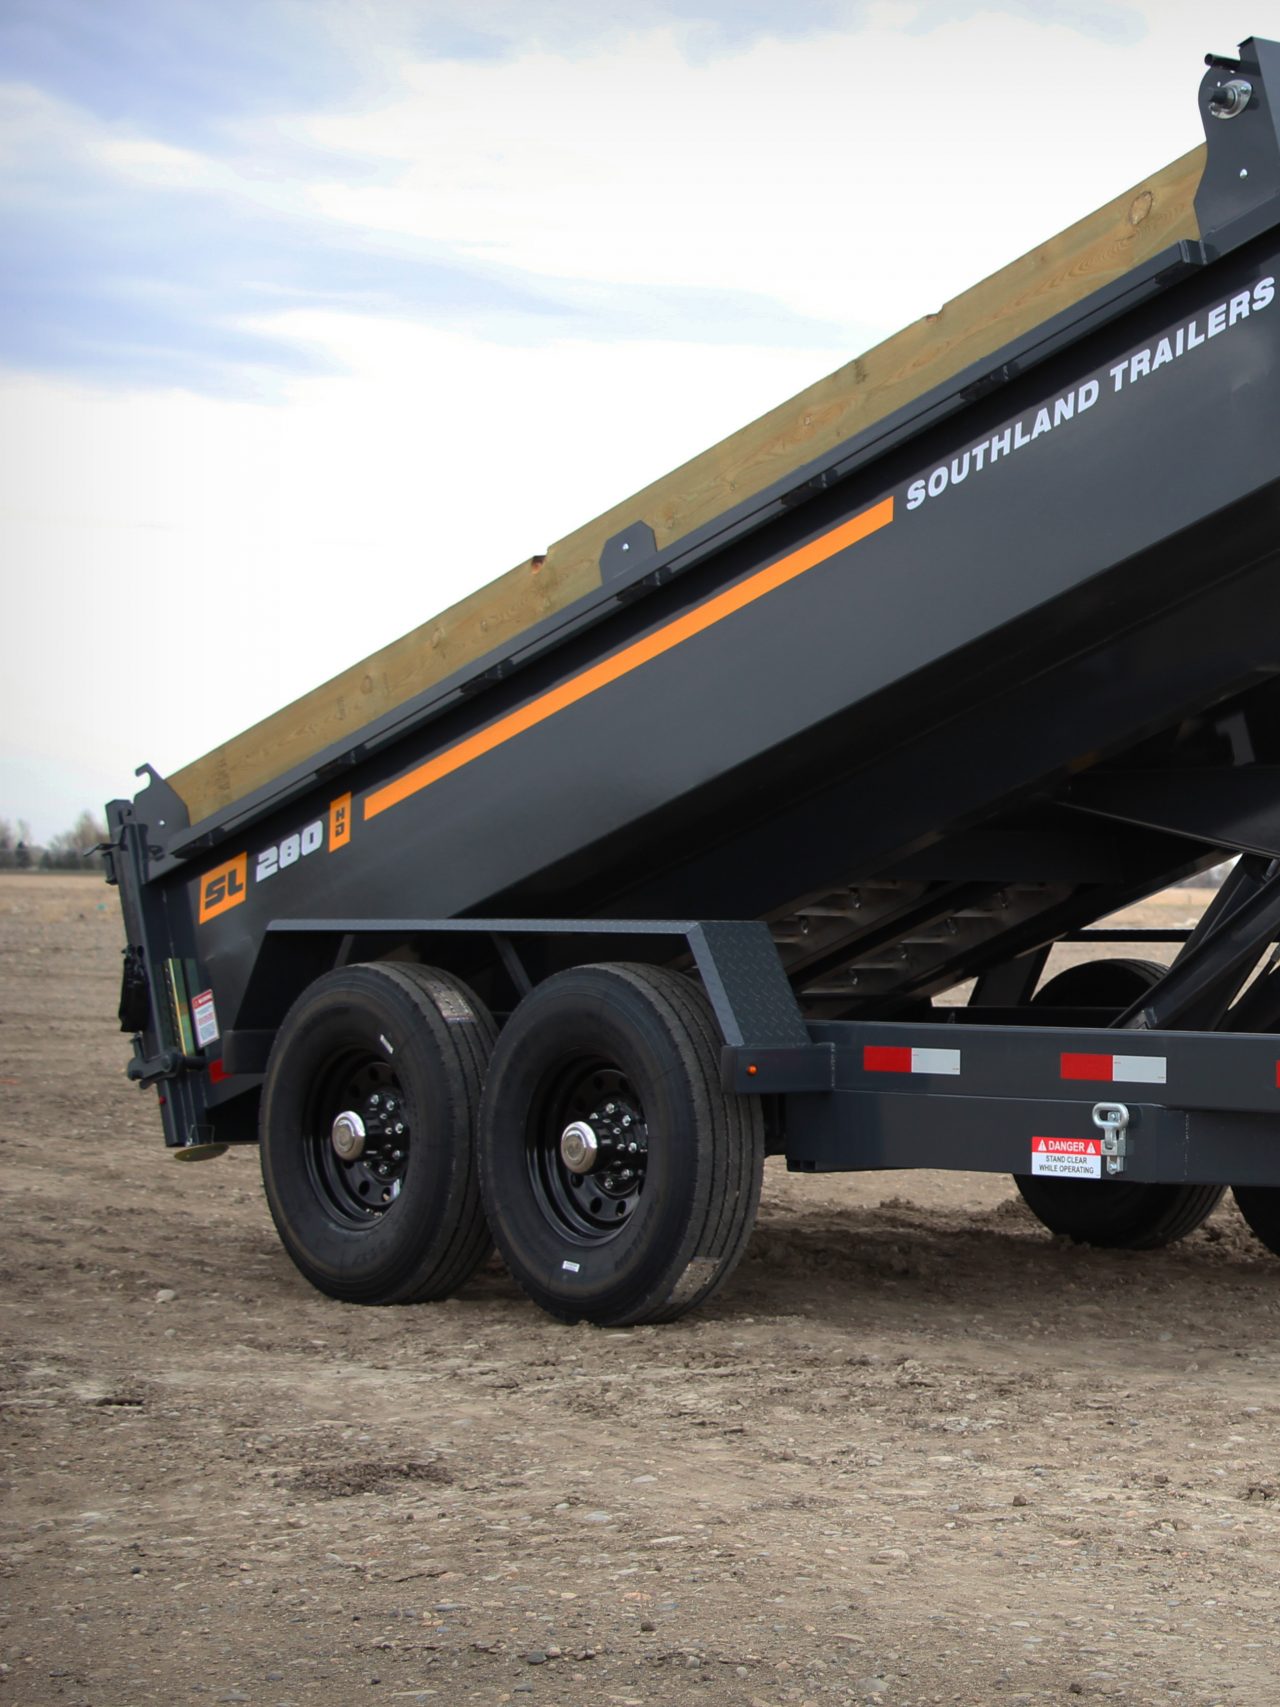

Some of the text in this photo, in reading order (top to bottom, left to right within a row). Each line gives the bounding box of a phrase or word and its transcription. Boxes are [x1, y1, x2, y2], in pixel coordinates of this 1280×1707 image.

[906, 276, 1275, 511] SOUTHLAND TRAILERS
[204, 868, 244, 910] SL
[255, 820, 323, 883] 280
[1048, 1141, 1085, 1152] DANGER
[1046, 1155, 1087, 1164] STAND CLEAR
[1039, 1164, 1094, 1174] WHILE OPERATING
